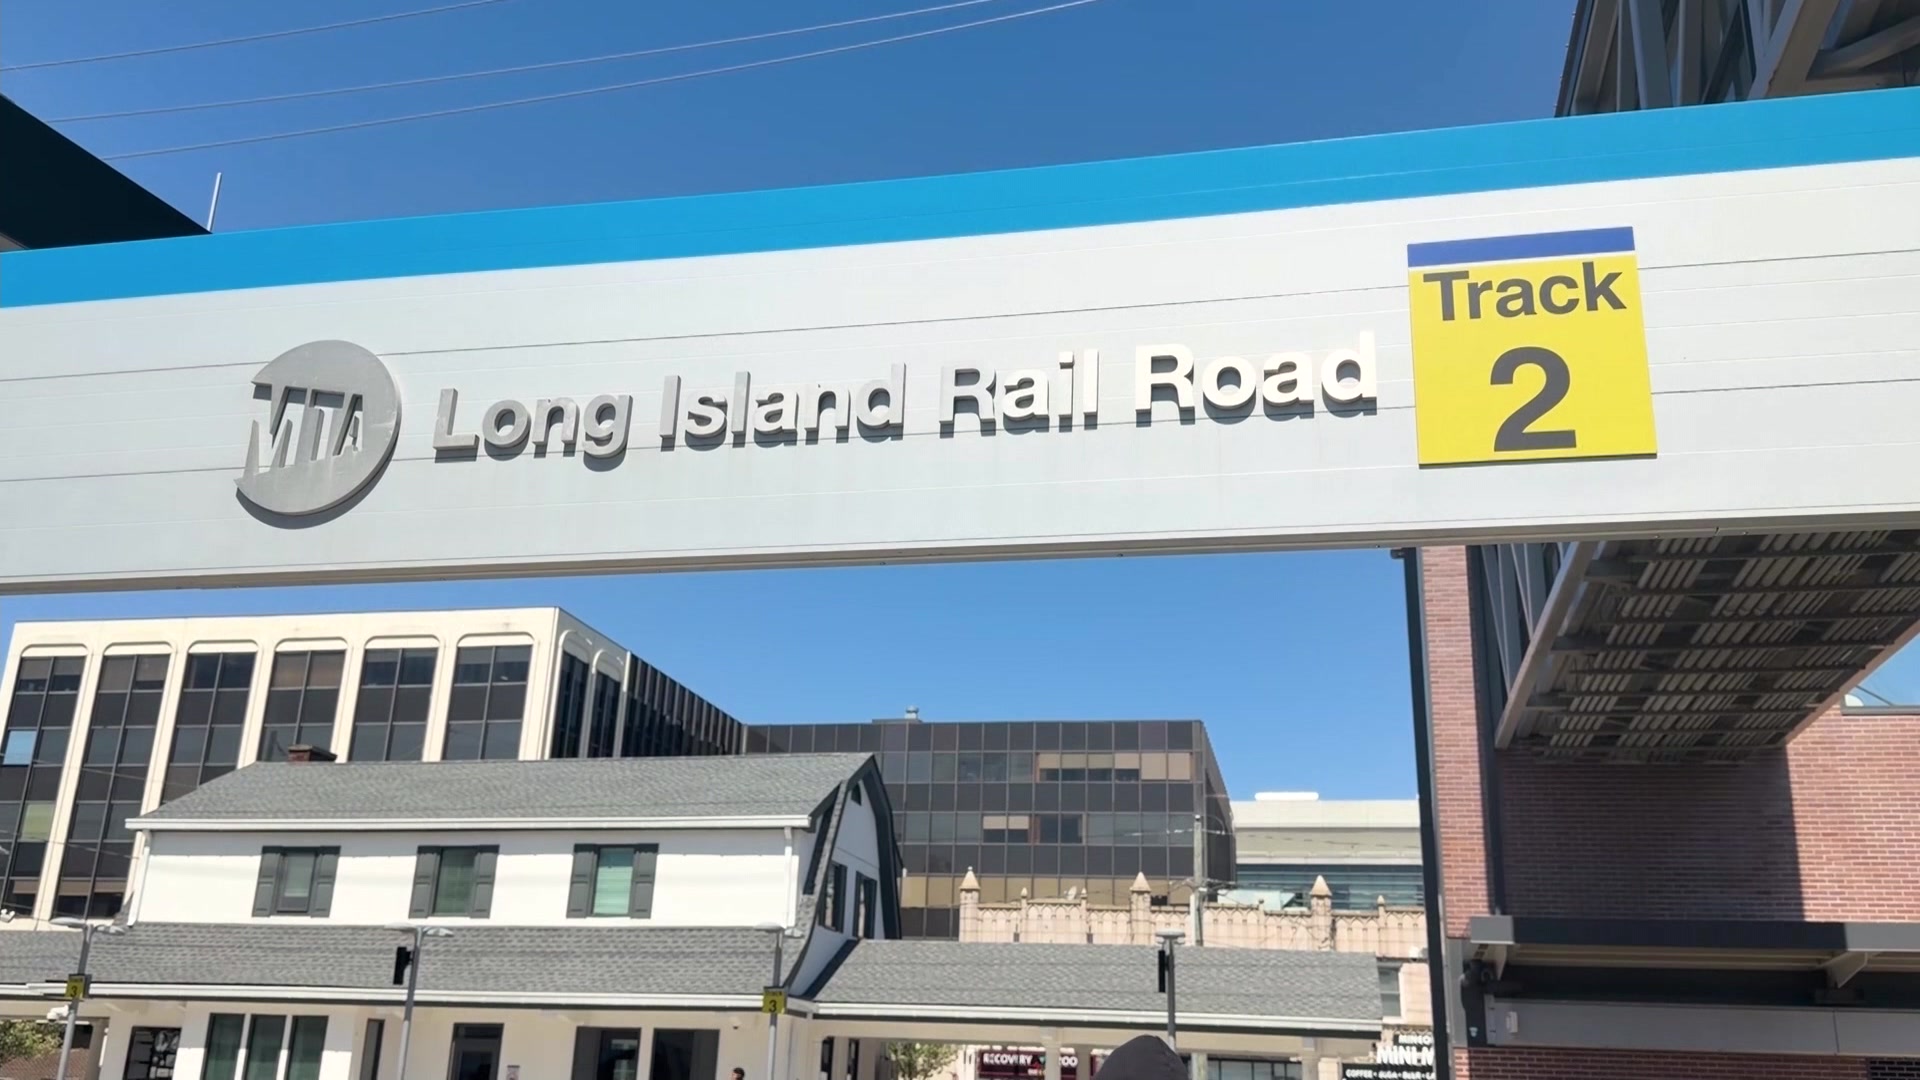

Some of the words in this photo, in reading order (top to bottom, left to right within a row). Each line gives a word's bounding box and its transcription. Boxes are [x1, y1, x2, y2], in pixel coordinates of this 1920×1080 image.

[1423, 262, 1627, 321] Track
[239, 384, 364, 478] MTA
[433, 387, 632, 460] Long
[659, 363, 906, 440] Island
[939, 349, 1098, 426] Rail
[1135, 330, 1378, 412] Road
[1489, 346, 1577, 453] 2
[768, 999, 778, 1013] 3
